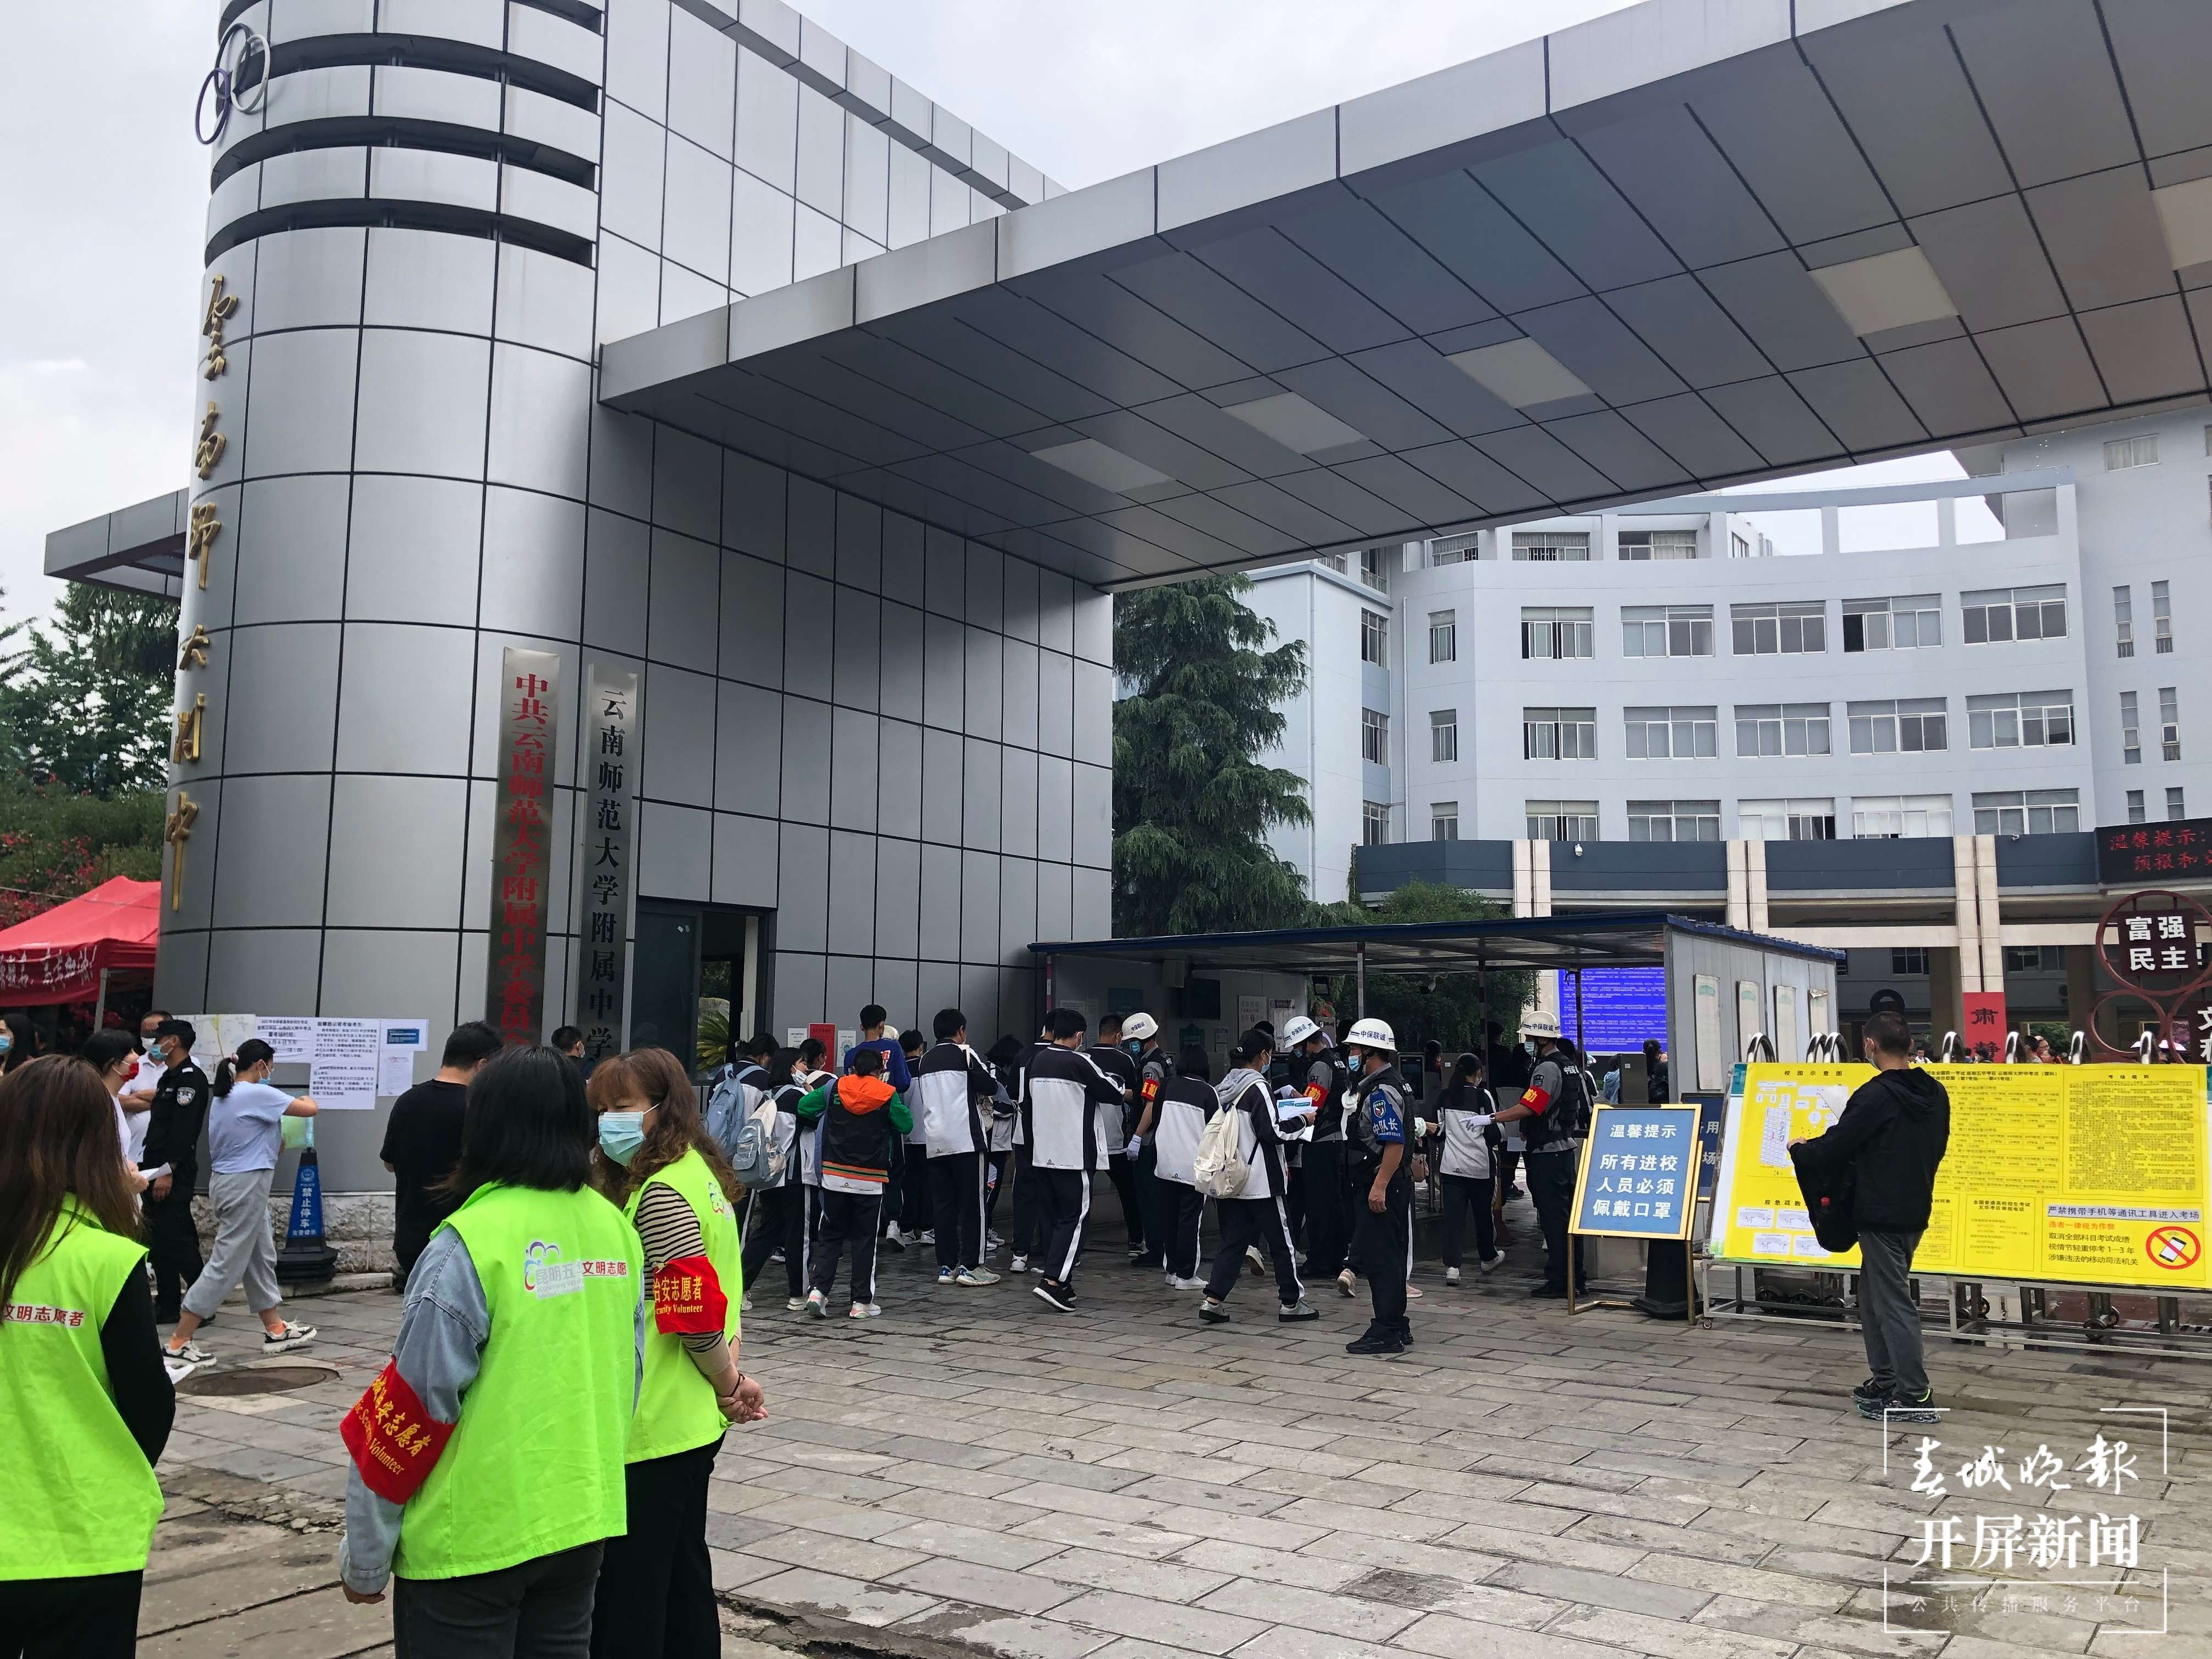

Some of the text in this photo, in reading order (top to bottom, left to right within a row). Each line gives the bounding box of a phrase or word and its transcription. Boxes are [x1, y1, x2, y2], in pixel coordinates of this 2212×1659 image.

[585, 690, 627, 1059] 云南师范大学附属中学
[2125, 916, 2186, 941] 富强
[2129, 946, 2189, 971] 民主
[1360, 1030, 1386, 1041] 中保联诚
[1373, 1118, 1398, 1135] 中队长
[1610, 1124, 1677, 1139] 温馨提示
[1599, 1154, 1679, 1172] 所有进校
[1596, 1177, 1675, 1195] 人员必须
[300, 1187, 312, 1228] 禁止停车
[1593, 1198, 1672, 1219] 佩戴口罩
[2047, 1206, 2200, 1220] 严禁携带手机等通讯工具进入考场
[2049, 1232, 2130, 1244] 取消全部科目考试成绩
[582, 1261, 627, 1276] 文明志愿
[3, 1304, 84, 1327] 文明志愿者
[673, 1304, 703, 1314] Volunteer
[369, 1437, 405, 1475] Volunteer
